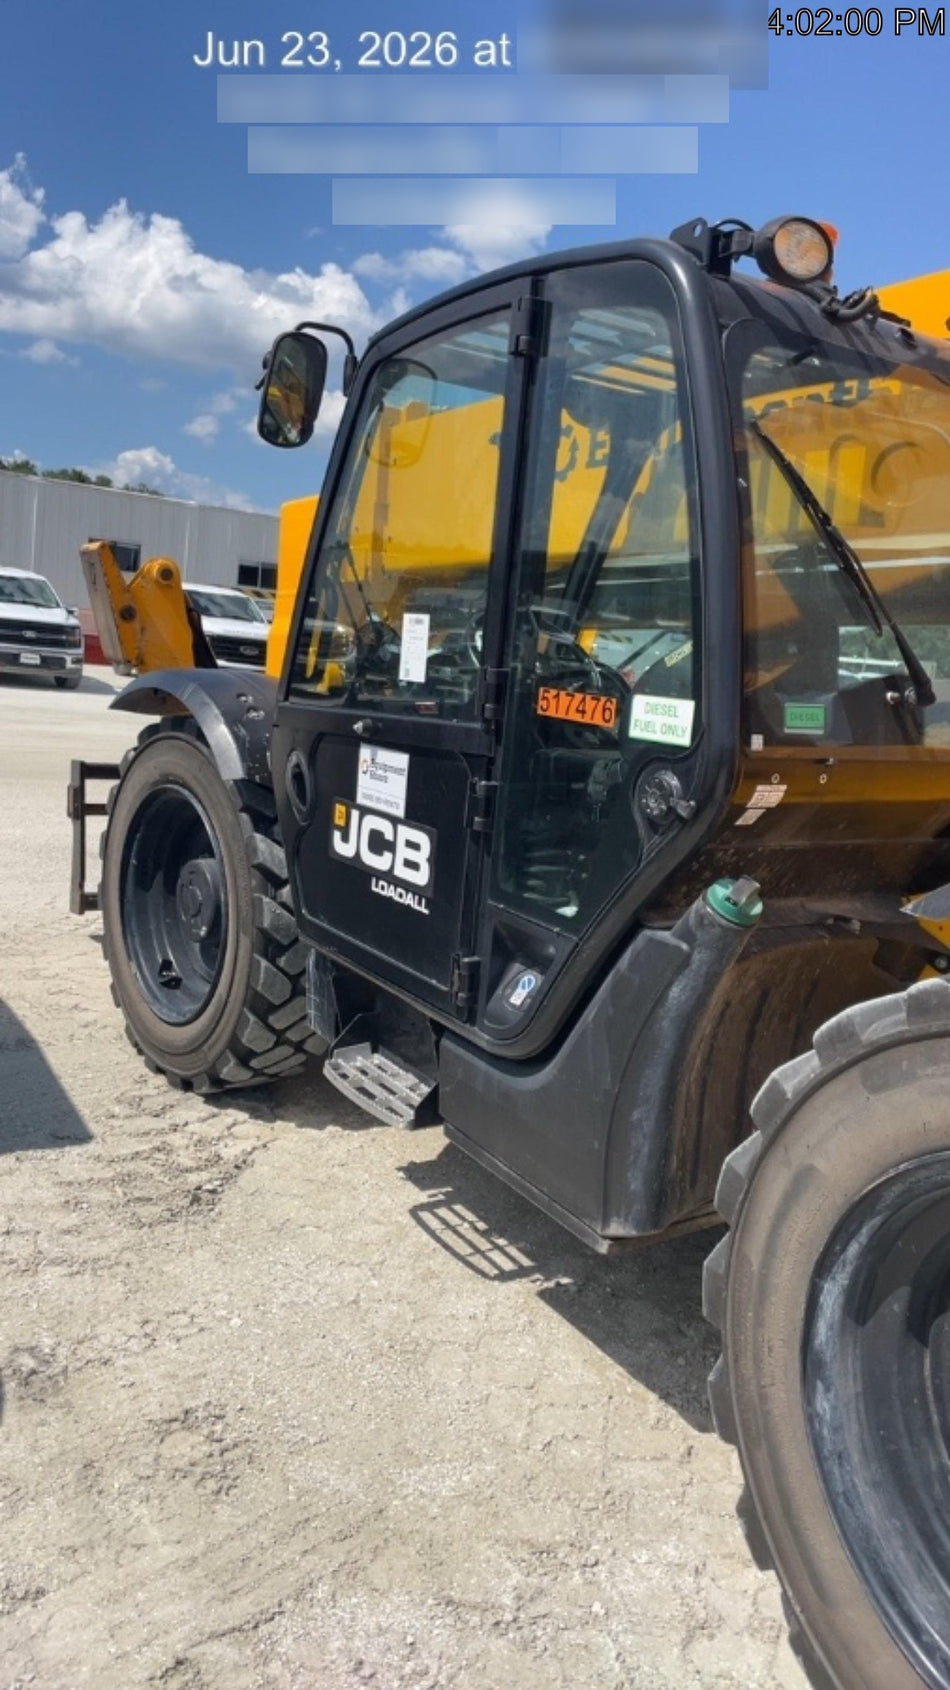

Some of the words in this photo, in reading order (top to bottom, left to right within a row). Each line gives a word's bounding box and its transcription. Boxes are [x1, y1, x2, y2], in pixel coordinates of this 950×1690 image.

[539, 689, 615, 725] 517476
[643, 701, 680, 718] DIESEL
[633, 718, 658, 735] FUEL
[660, 722, 688, 738] ONLY
[332, 806, 432, 888] JCB
[370, 876, 431, 915] LOADALL
